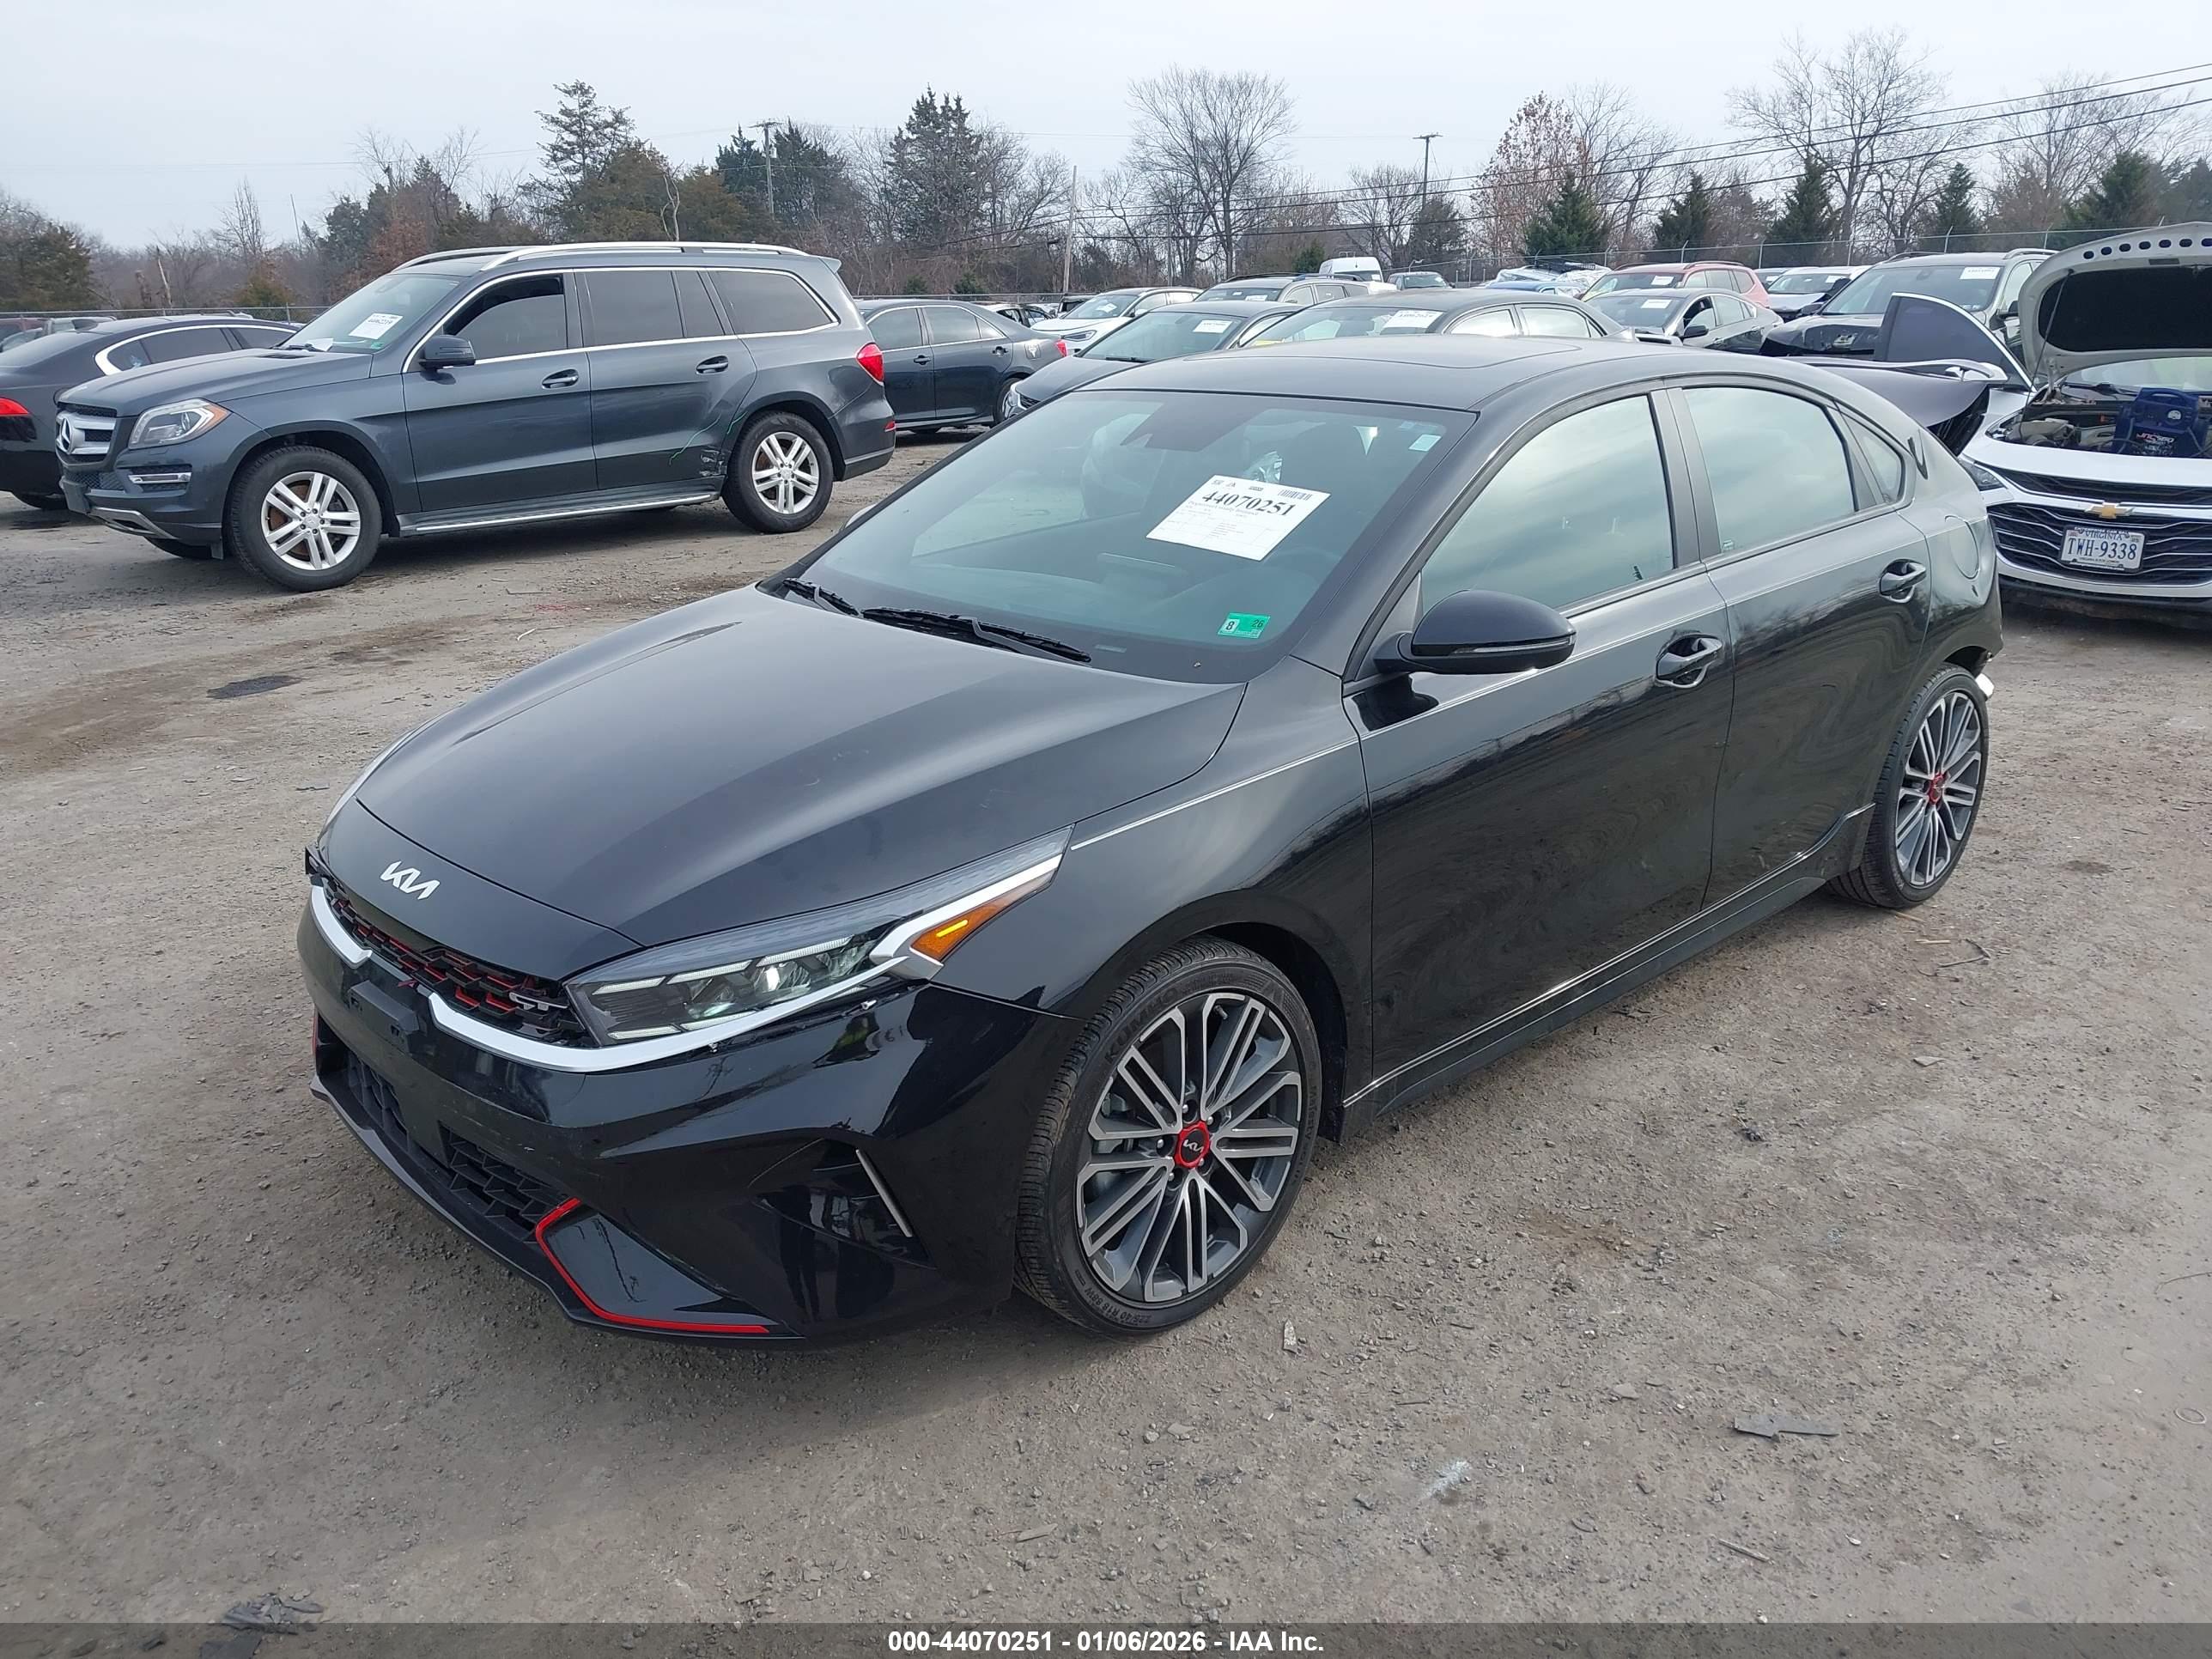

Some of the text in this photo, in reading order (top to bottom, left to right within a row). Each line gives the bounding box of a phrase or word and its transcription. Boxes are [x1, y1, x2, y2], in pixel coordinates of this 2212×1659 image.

[1202, 490, 1297, 516] 44070251
[2068, 537, 2137, 561] TWH-9338
[1225, 618, 1265, 631] 8 26
[380, 860, 441, 900] KIA
